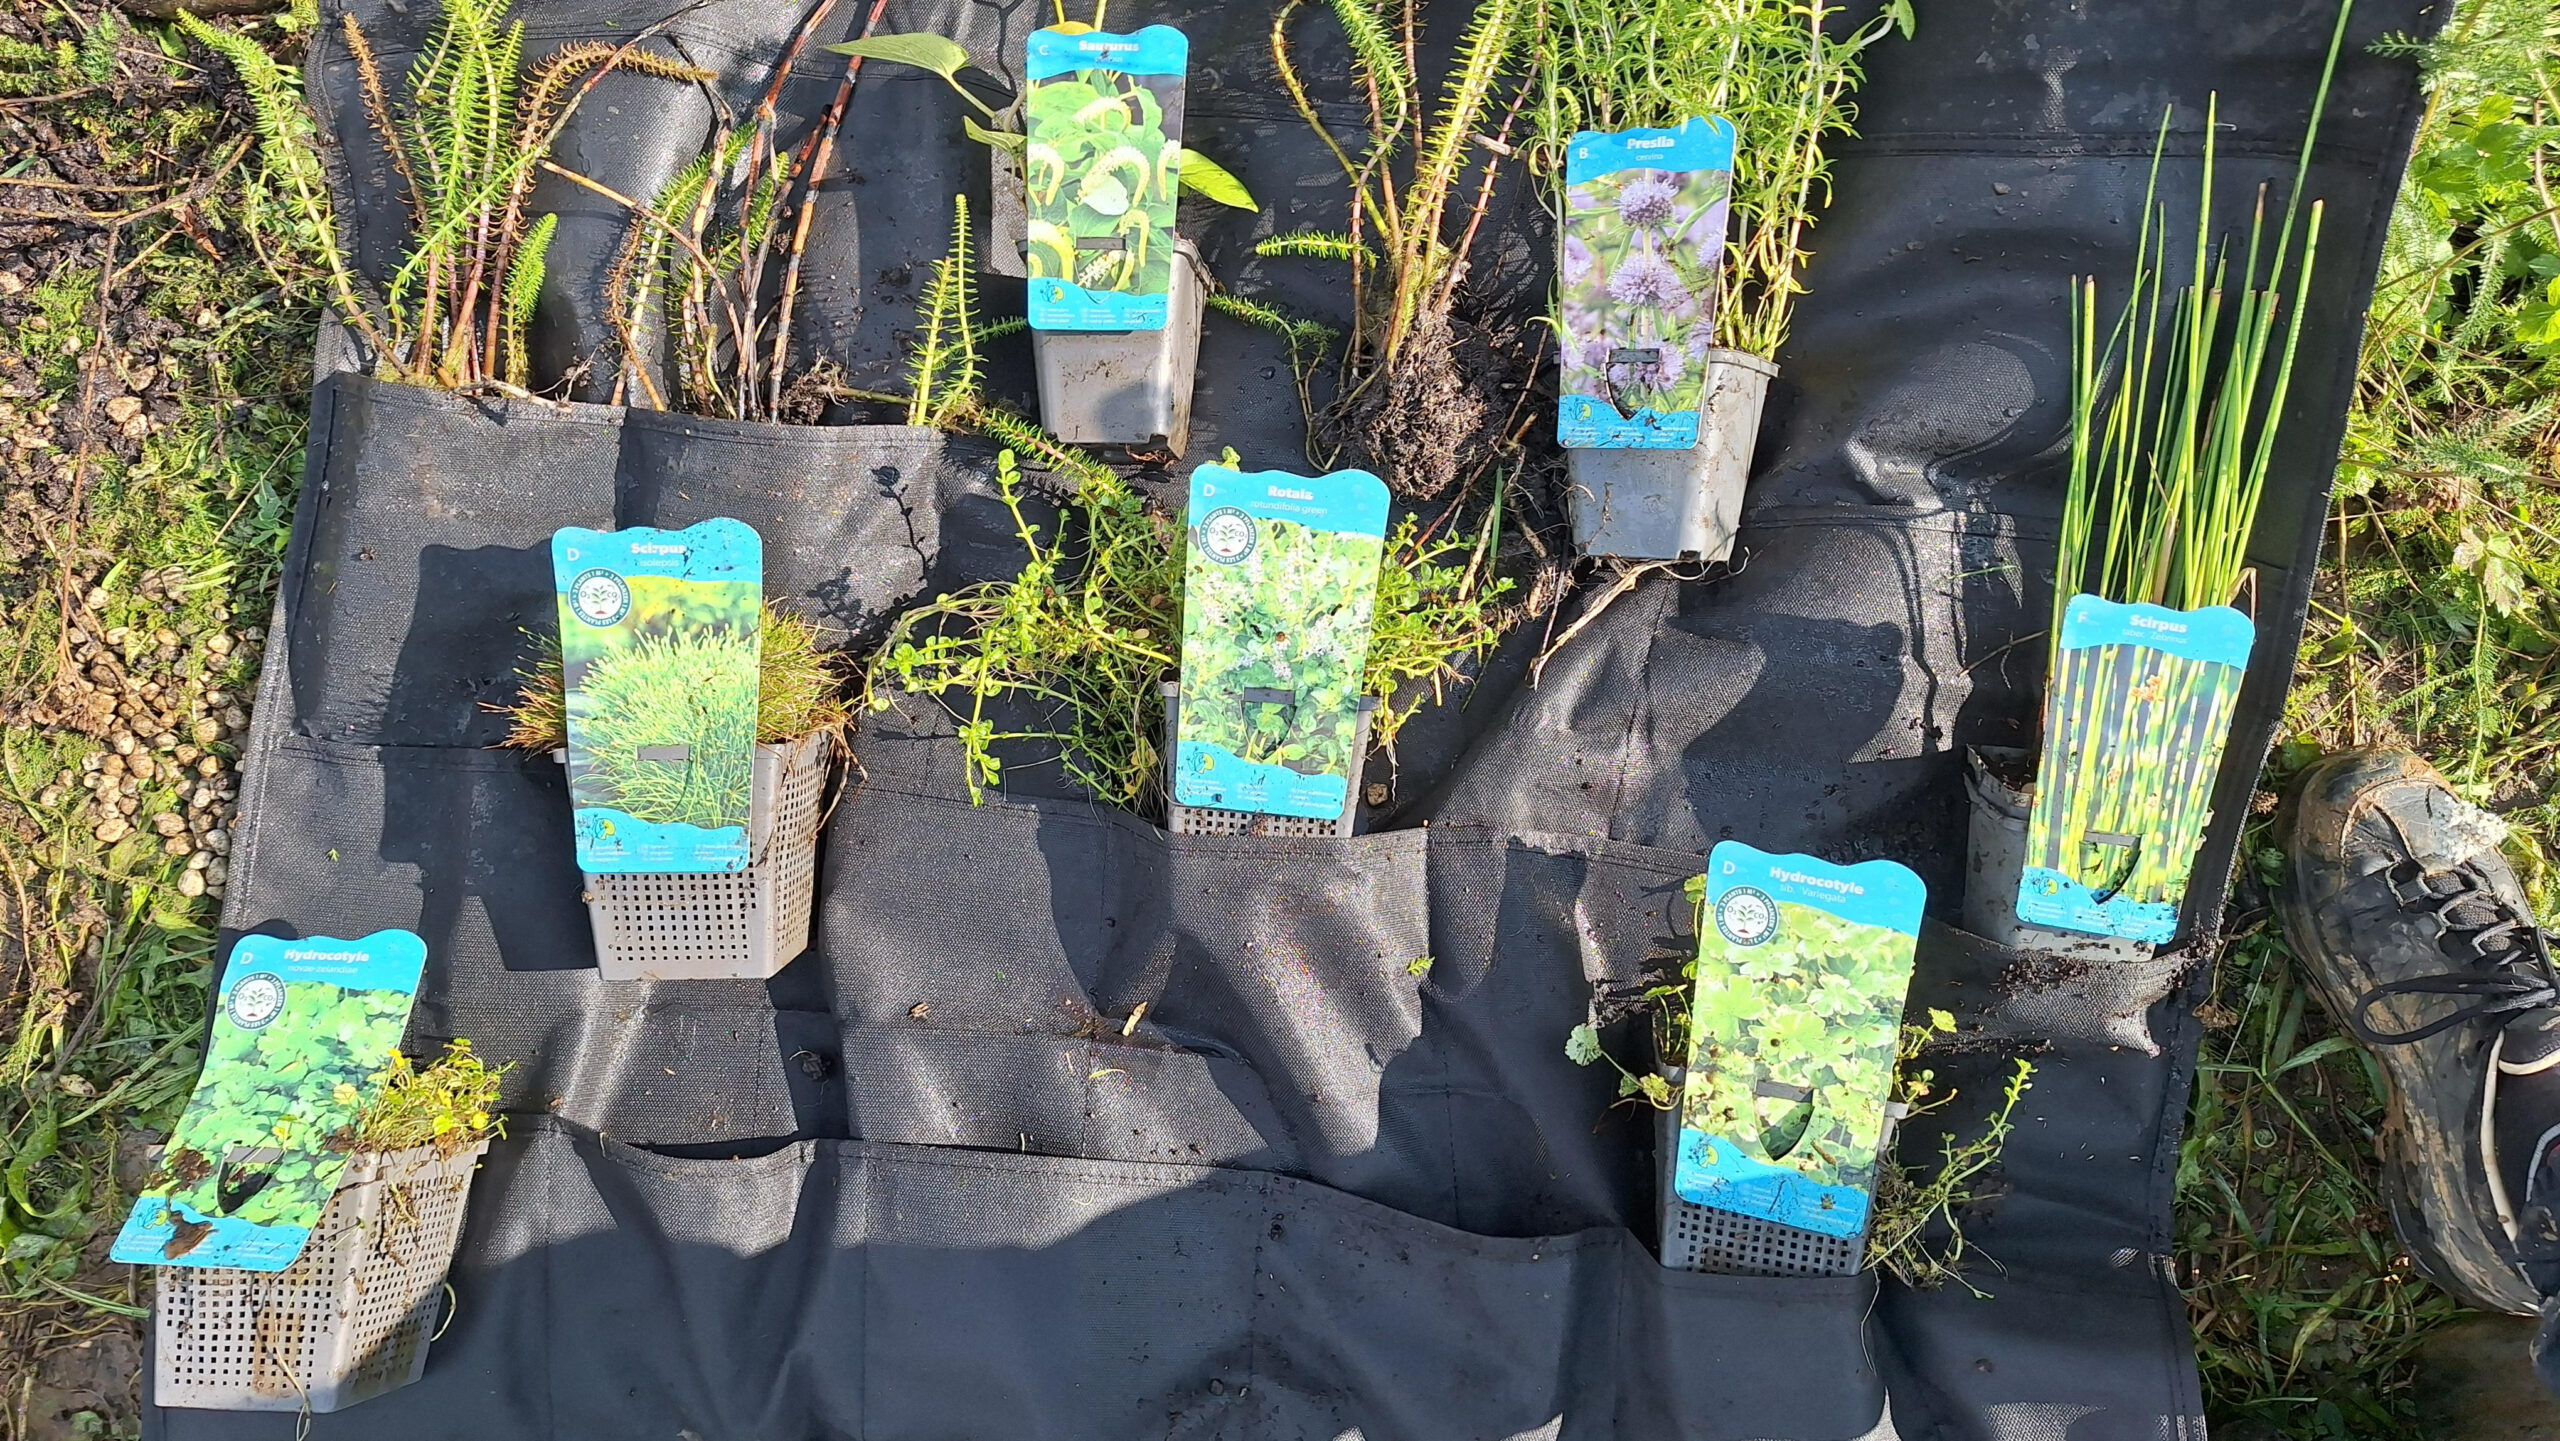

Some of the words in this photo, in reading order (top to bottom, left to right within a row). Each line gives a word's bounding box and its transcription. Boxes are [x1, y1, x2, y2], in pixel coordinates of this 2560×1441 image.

[1038, 45, 1049, 55] C
[1079, 40, 1139, 51] Saururus
[1627, 135, 1675, 149] Preslia
[1579, 147, 1589, 160] B
[1203, 484, 1215, 497] D
[1268, 485, 1314, 500] Rotala
[1250, 501, 1301, 513] rotundifolia
[1301, 506, 1328, 517] green
[566, 548, 580, 561] D
[631, 541, 687, 556] Scirpus
[2078, 611, 2088, 624] F
[2129, 614, 2187, 633] Scirpus
[1722, 861, 1736, 874] D
[1769, 866, 1865, 895] Hydrocotyle
[240, 952, 253, 965] D
[284, 949, 370, 963] Hydrocotyle
